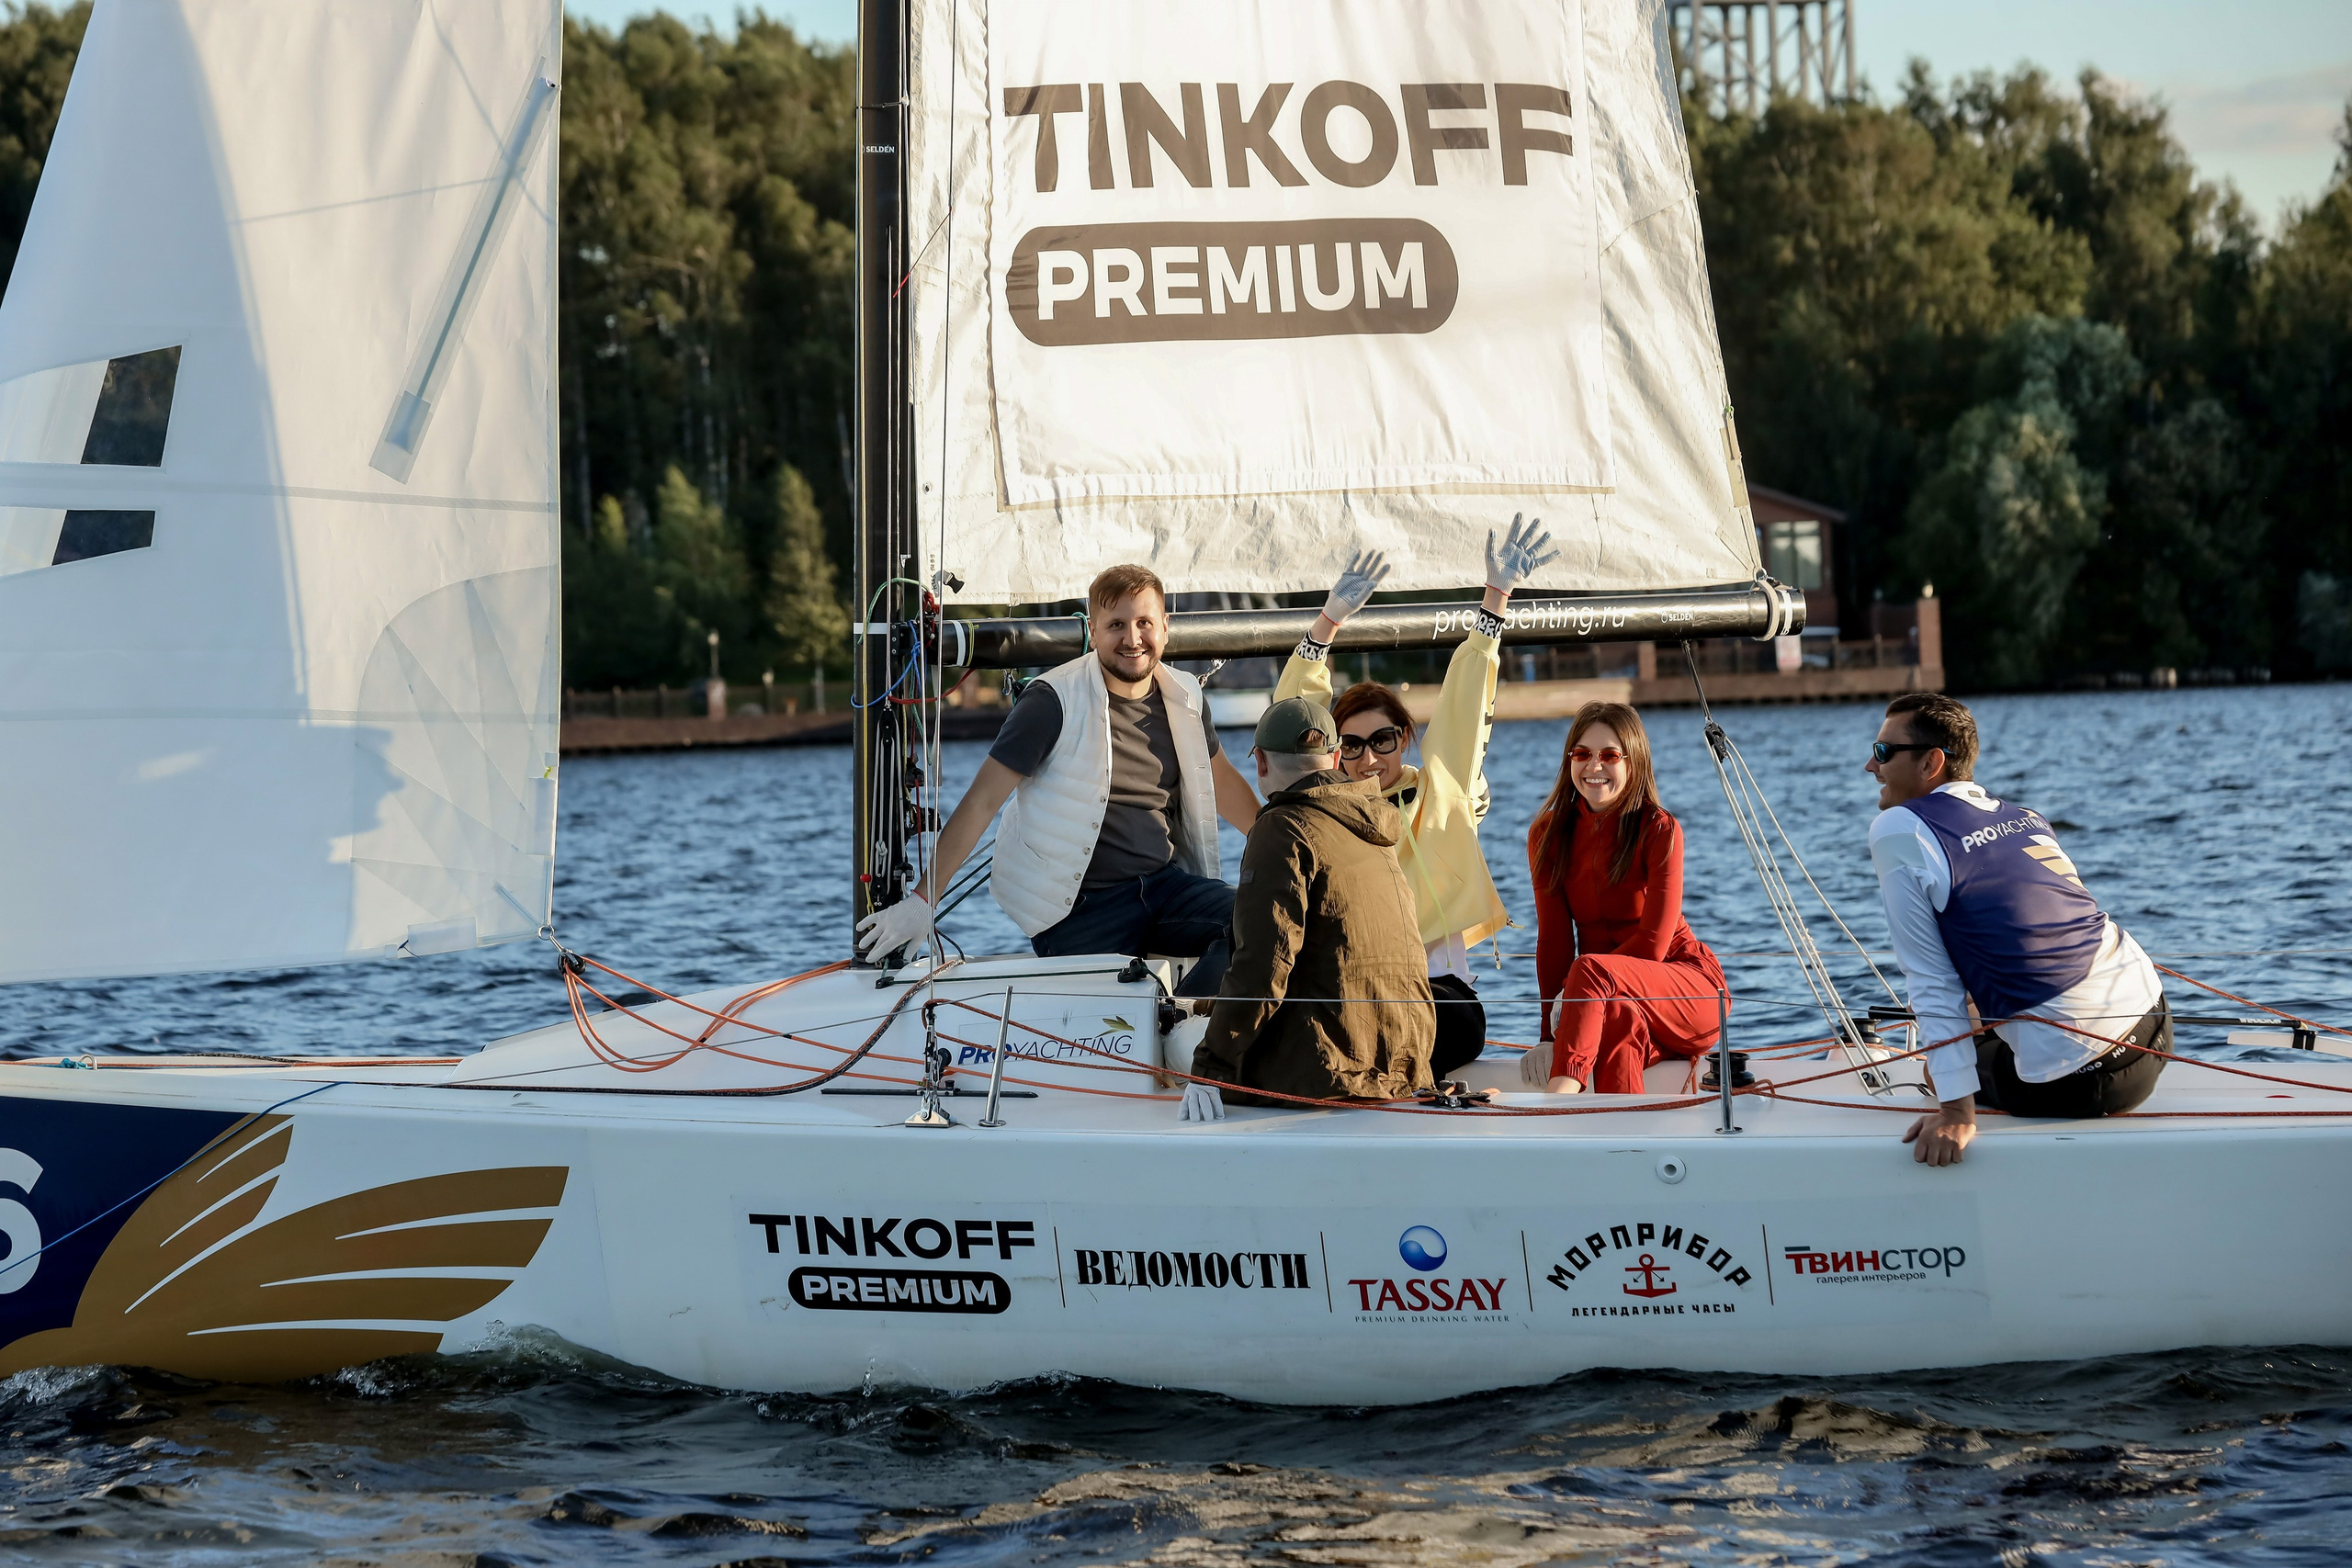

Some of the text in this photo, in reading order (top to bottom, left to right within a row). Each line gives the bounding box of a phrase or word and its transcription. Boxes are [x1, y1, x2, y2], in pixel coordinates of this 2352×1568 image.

[1003, 80, 1574, 193] TINKOFF
[1036, 242, 1428, 321] PREMIUM
[1432, 600, 1626, 640] proachting.ru
[2111, 1034, 2137, 1059] HUO
[748, 1213, 1036, 1260] TINKOFF
[1073, 1248, 1312, 1292] ВЕДОМОСТИ
[1546, 1223, 1753, 1292] МОРПРИБОР
[801, 1274, 998, 1306] PREMIUM
[1347, 1278, 1509, 1312] TASSAY
[1816, 1271, 1927, 1285] галерея интерьеров
[1473, 1314, 1510, 1323] WATER
[1571, 1303, 1736, 1316] ЛЕГЕНДАРНЫЕ ЧАСЫ
